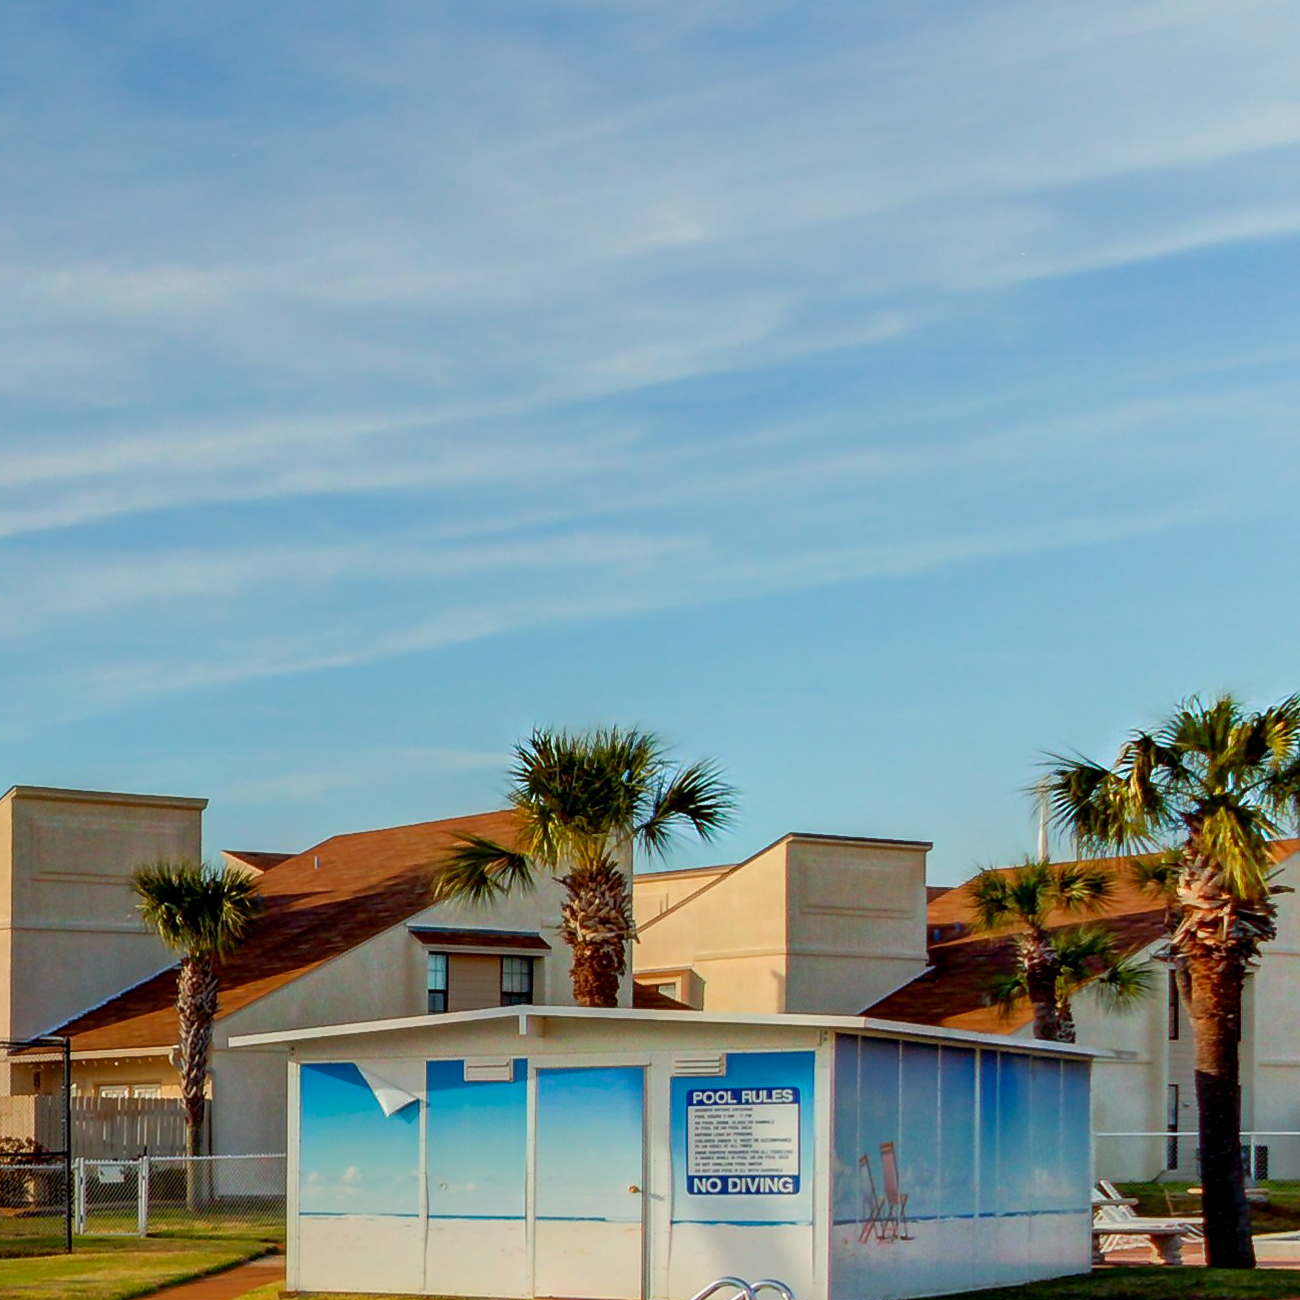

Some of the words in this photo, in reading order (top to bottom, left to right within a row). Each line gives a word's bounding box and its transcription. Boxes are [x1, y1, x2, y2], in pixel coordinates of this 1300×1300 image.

[692, 1090, 737, 1104] POOL
[741, 1089, 794, 1103] RULES
[693, 1177, 722, 1193] NO
[727, 1177, 793, 1193] DIVING
